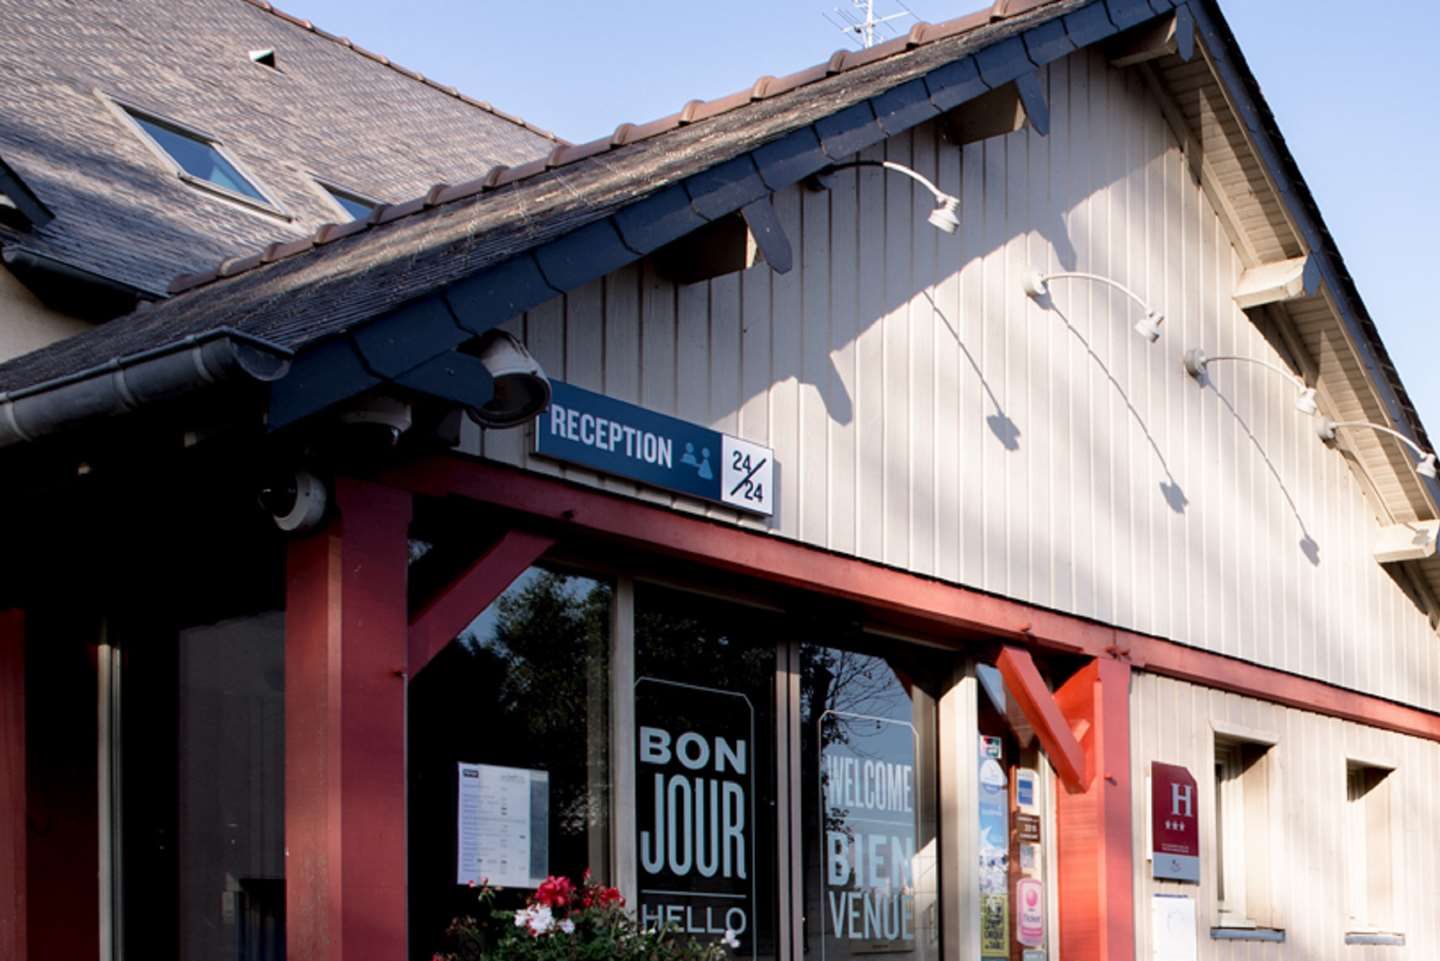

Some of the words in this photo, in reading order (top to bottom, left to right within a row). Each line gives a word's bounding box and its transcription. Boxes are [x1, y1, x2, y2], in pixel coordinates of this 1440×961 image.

[550, 403, 673, 469] RECEPTION
[639, 726, 747, 775] BON
[826, 754, 912, 812] WELCOME
[1171, 782, 1193, 817] H
[640, 773, 747, 879] JOUR
[826, 830, 913, 890] BIEN
[641, 904, 747, 935] HELLO
[828, 890, 913, 940] VENUE
